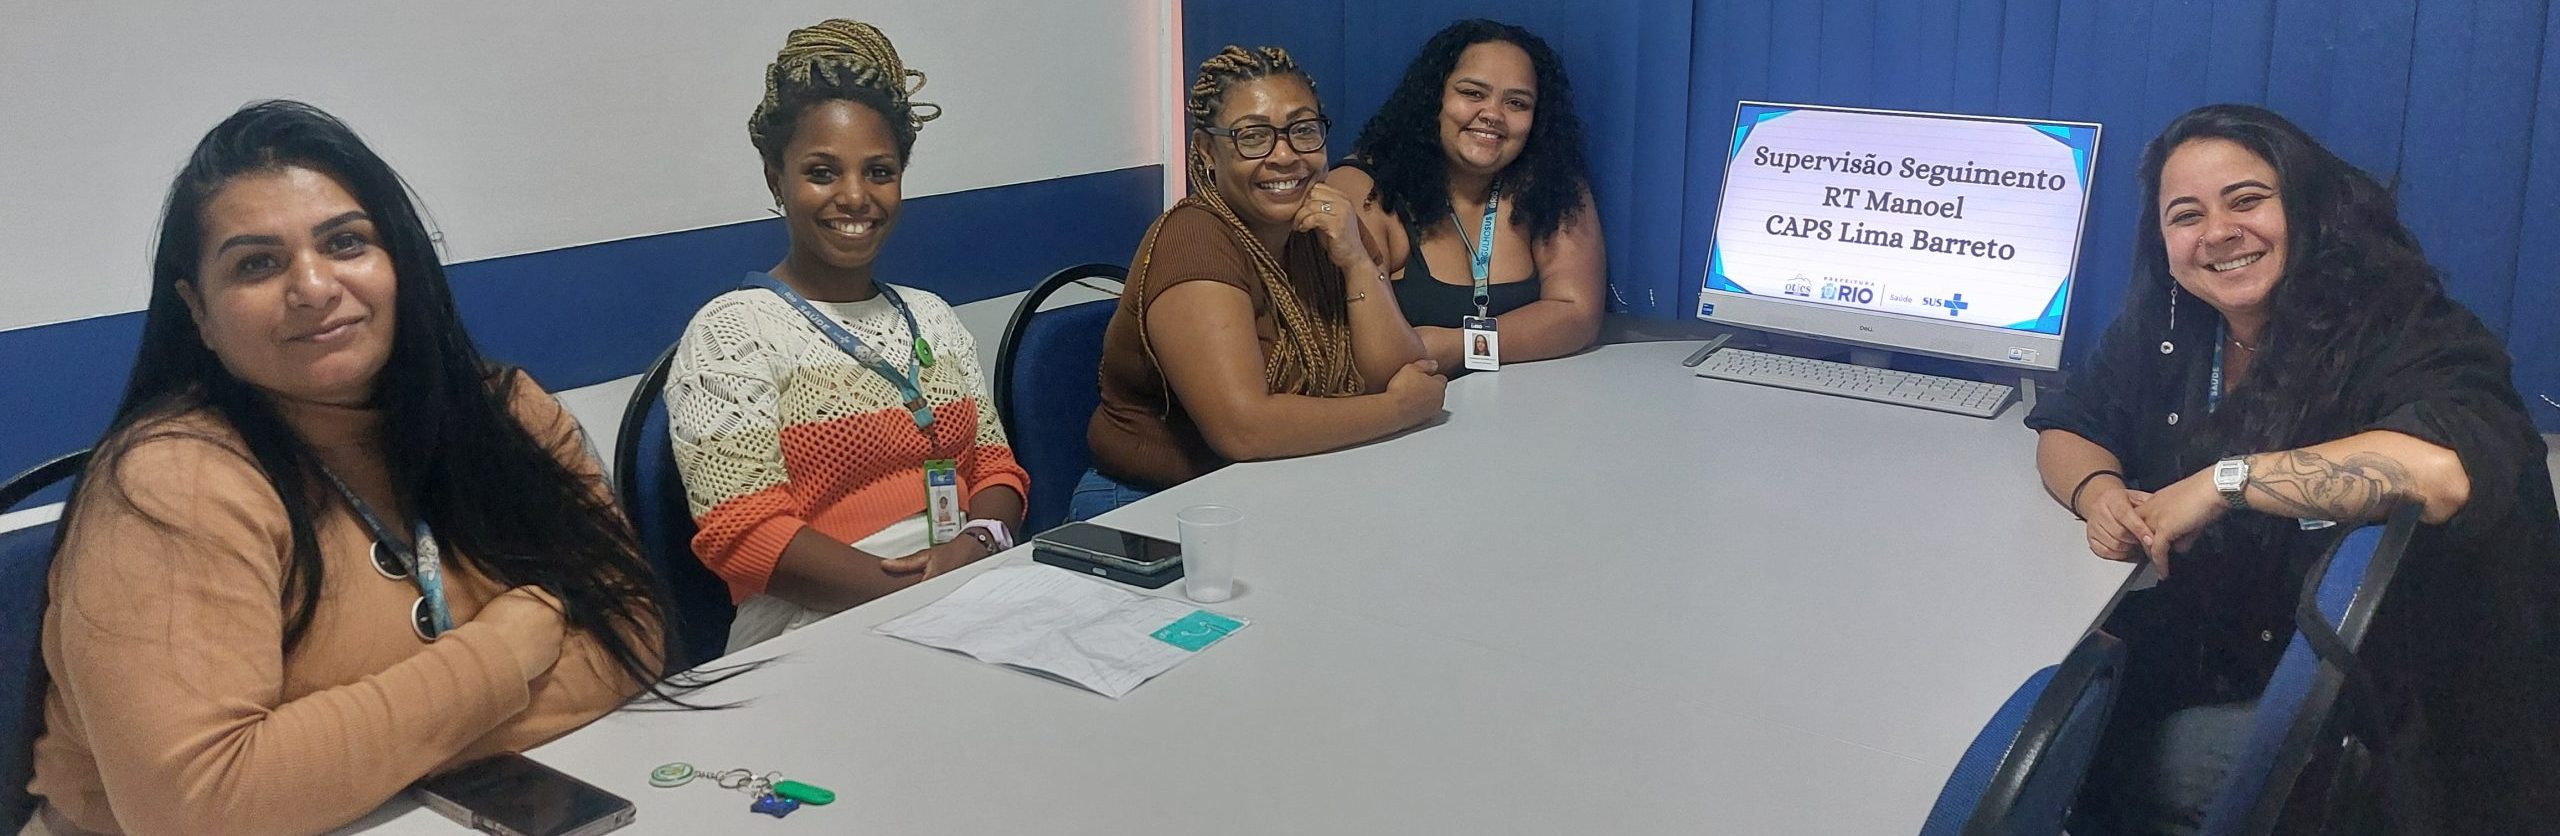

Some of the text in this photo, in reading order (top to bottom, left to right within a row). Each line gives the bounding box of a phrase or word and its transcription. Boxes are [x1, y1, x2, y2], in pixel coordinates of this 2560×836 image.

[1754, 146, 2066, 191] Supervisão Seguimento
[1822, 186, 1964, 219] RT Manoel
[1766, 214, 2016, 260] CAPS Lima Barreto
[1823, 276, 1875, 287] PREFEITURA
[1838, 285, 1873, 304] RIO
[1890, 294, 1912, 303] Saúde
[1922, 297, 1942, 307] SUS
